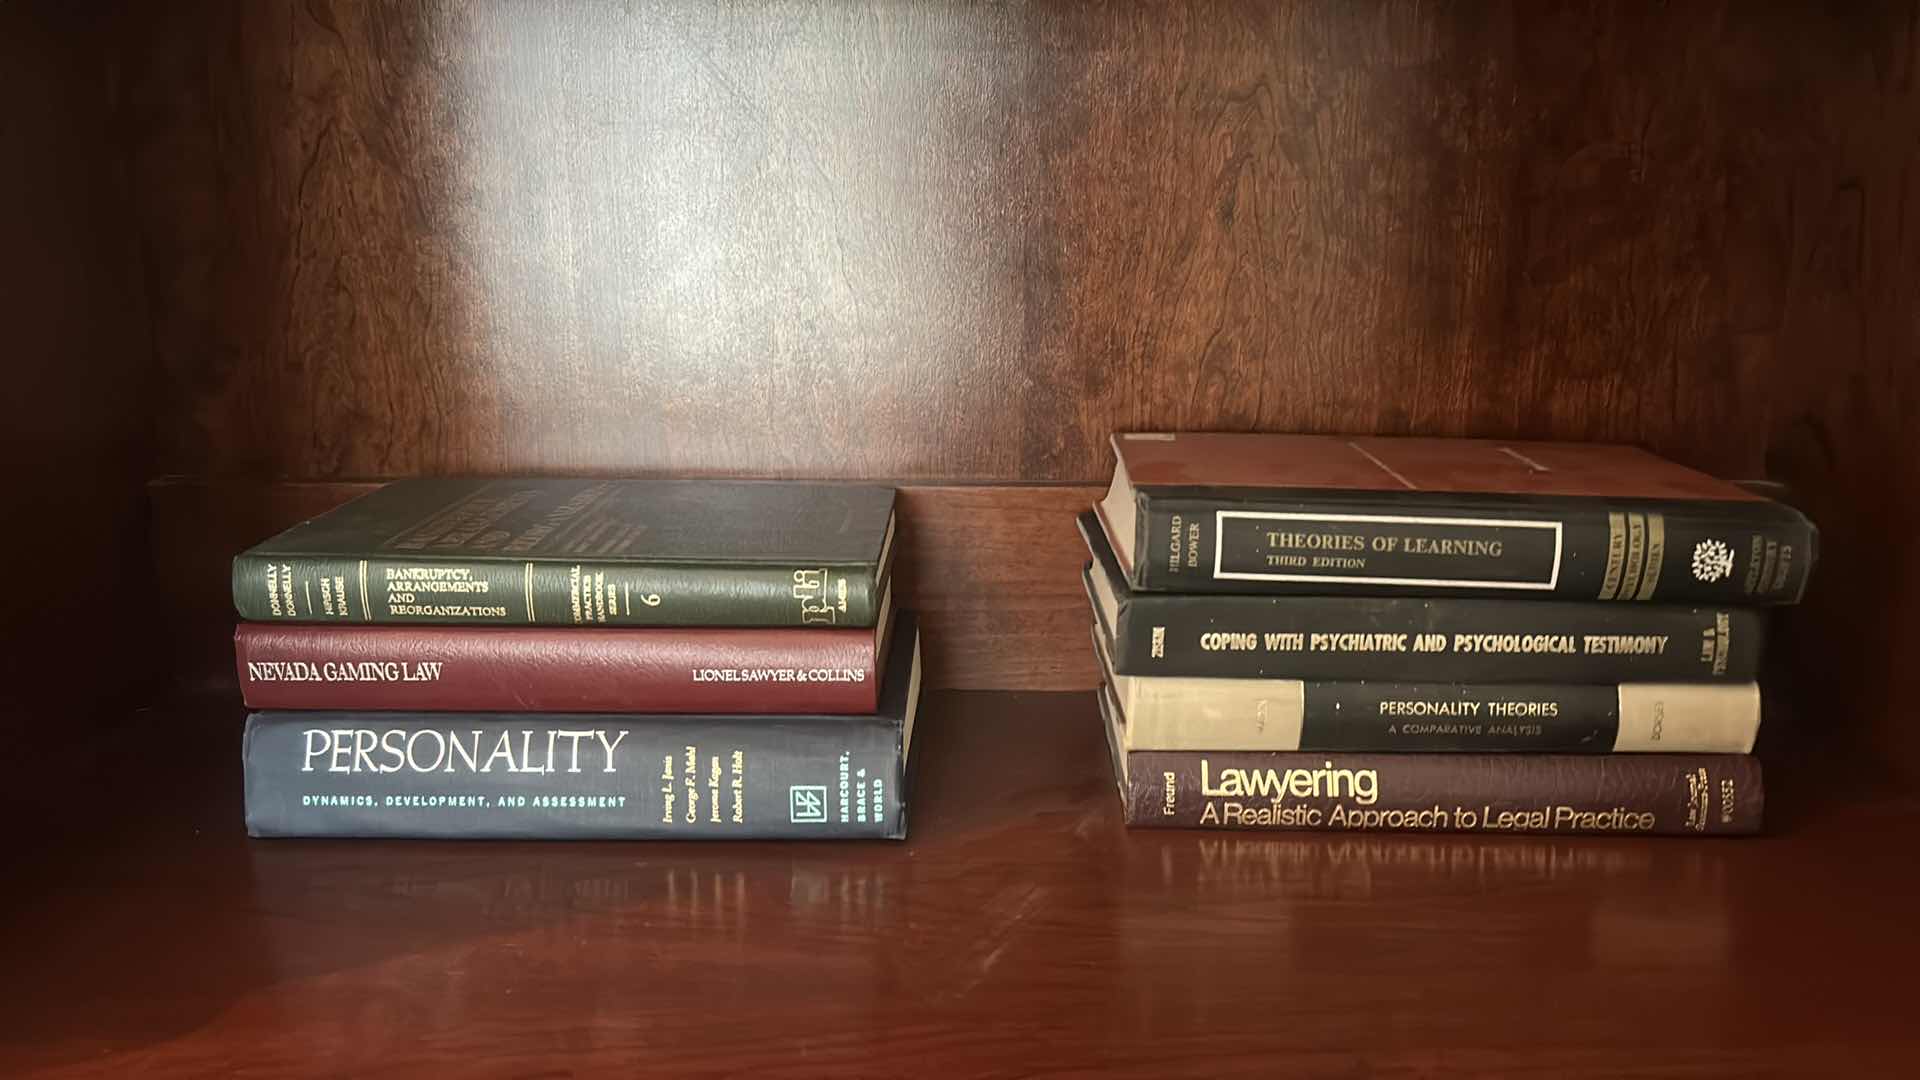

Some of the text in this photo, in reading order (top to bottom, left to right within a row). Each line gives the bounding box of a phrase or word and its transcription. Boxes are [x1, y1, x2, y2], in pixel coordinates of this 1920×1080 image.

[1187, 522, 1200, 568] BOWER
[1266, 531, 1503, 557] THEORIES OF LEARNING
[386, 568, 473, 582] BANKRUPTCY,
[1266, 555, 1366, 569] THIRD EDITION
[266, 563, 282, 616] DONNELLY
[281, 564, 297, 616] DONNELLY
[335, 576, 349, 616] KRAUSE
[386, 581, 490, 593] ARRANGEMENTS
[387, 593, 416, 604] AND
[607, 583, 617, 616] SERIES
[640, 594, 661, 607] 6
[390, 604, 507, 617] REORGANIZATIONS
[1200, 632, 1669, 655] COPING WITH PSYCHIATRIC AND PSYCHOLOGICAL TESTIMONY
[247, 662, 443, 682] NEVADA GAMING LAW
[692, 669, 865, 682] LIONEL SAWYER & COLLINS
[1379, 701, 1559, 717] PERSONALITY THEORIES
[1388, 724, 1542, 736] A COMPARATIVE ANALYSIS
[301, 728, 629, 776] PERSONALITY
[661, 781, 673, 793] L.
[732, 776, 743, 788] R.
[839, 750, 851, 824] HARCOURT,
[856, 767, 867, 823] BRACE &
[1163, 771, 1176, 816] Freund
[1200, 759, 1379, 804] Lawyering
[302, 795, 627, 808] DYNAMICS, DEVELOPMENT, AND ASSESSMENT
[685, 787, 699, 824] George
[709, 789, 722, 823] Jerome
[732, 788, 744, 824] Robert
[872, 778, 884, 824] WORLD
[1200, 802, 1656, 831] A Realistic Approach to Legal Practice
